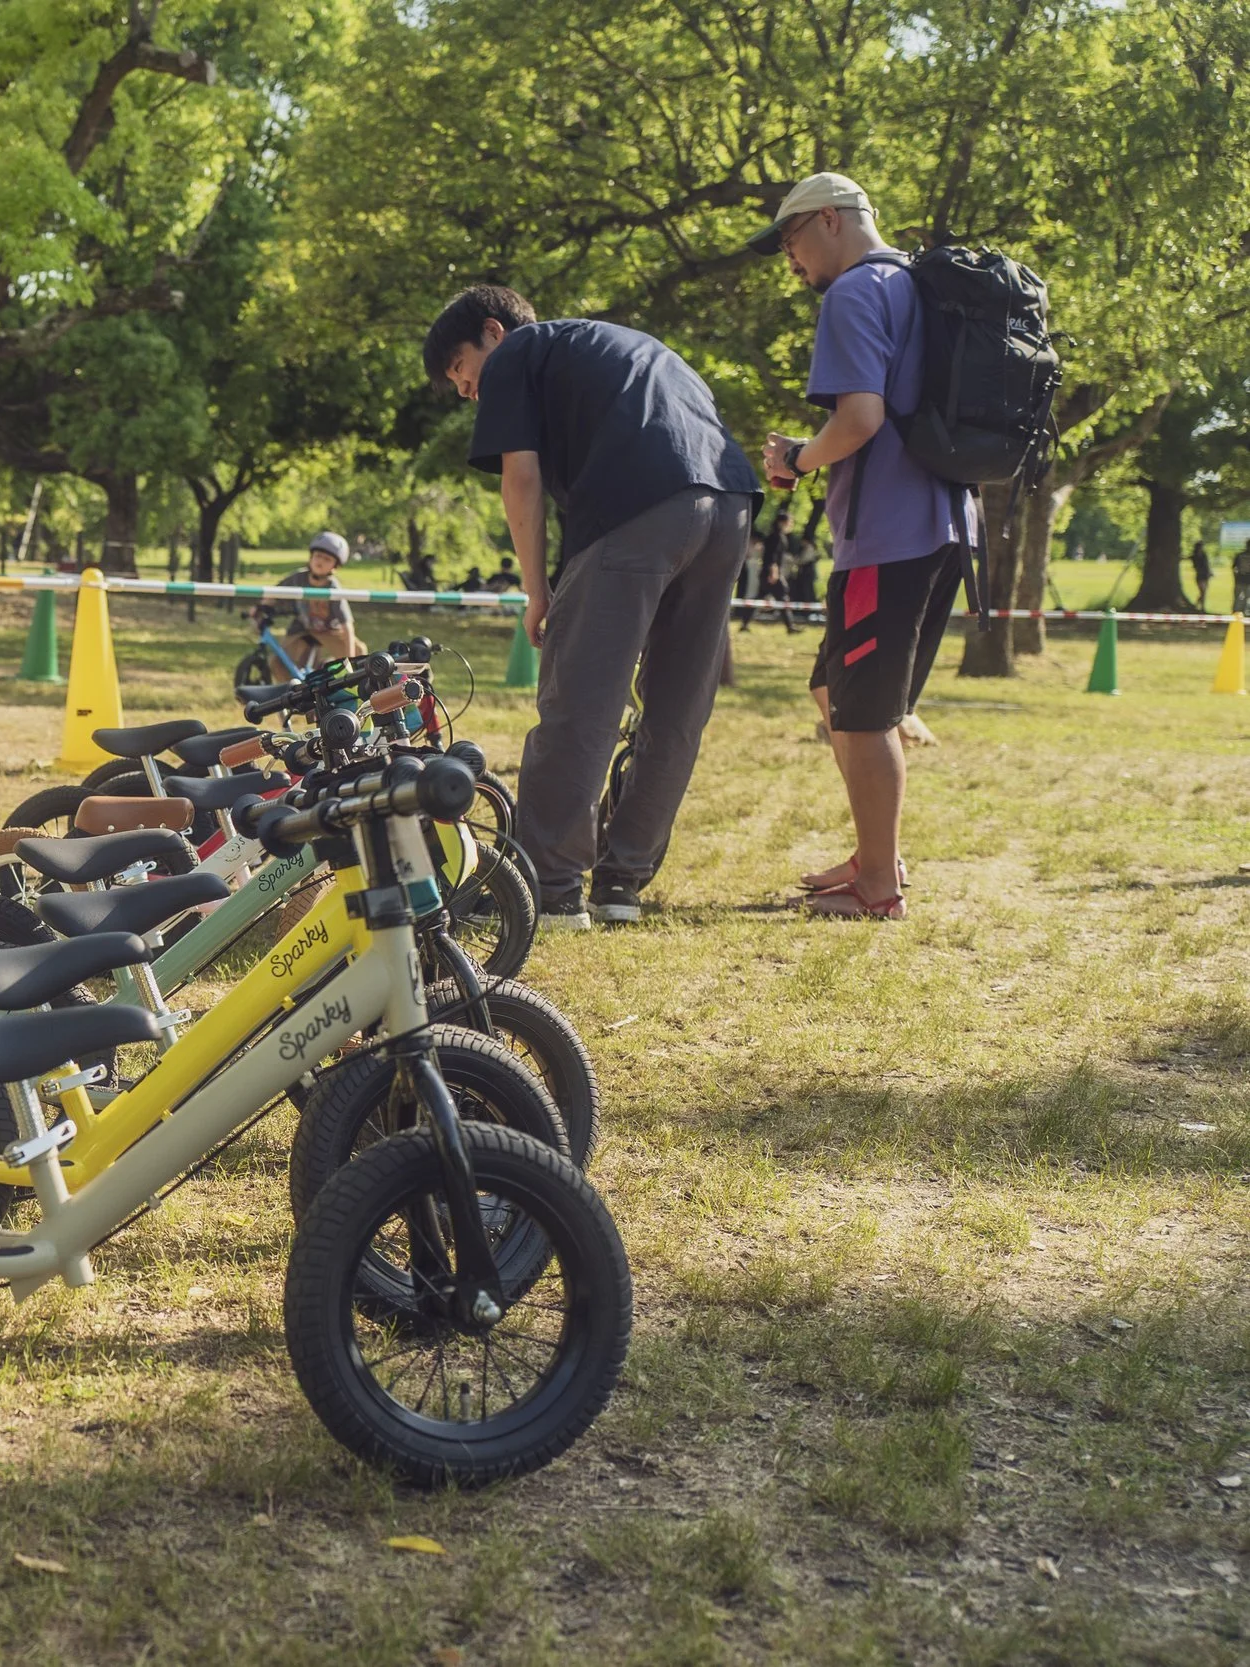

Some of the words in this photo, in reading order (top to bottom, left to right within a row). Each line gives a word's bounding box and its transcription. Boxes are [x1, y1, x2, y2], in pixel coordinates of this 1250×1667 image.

[258, 852, 304, 892] Sparky
[270, 919, 330, 978] Sparky
[278, 995, 352, 1061] Sparky
